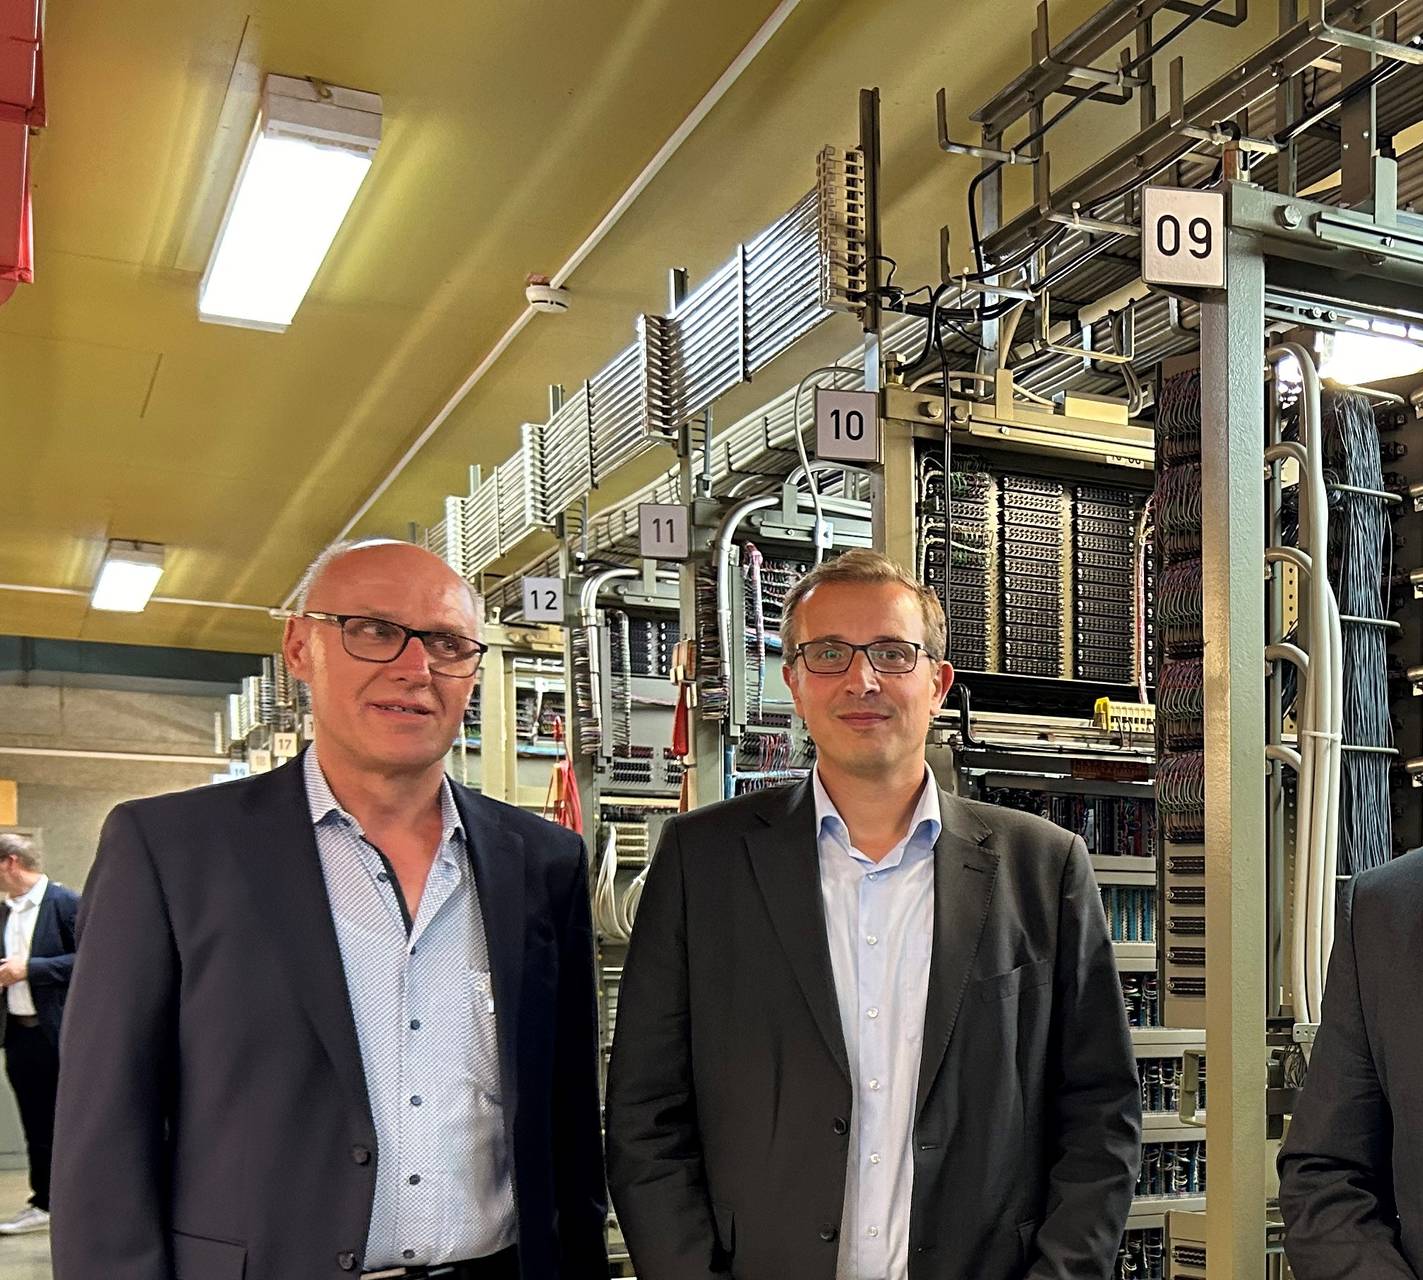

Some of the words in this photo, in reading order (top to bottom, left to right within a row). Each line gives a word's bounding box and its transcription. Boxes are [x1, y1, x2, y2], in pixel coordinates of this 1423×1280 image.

[1157, 214, 1212, 259] 09
[830, 409, 864, 441] 10
[653, 518, 673, 543] 11
[530, 590, 558, 610] 12
[278, 739, 292, 750] 17
